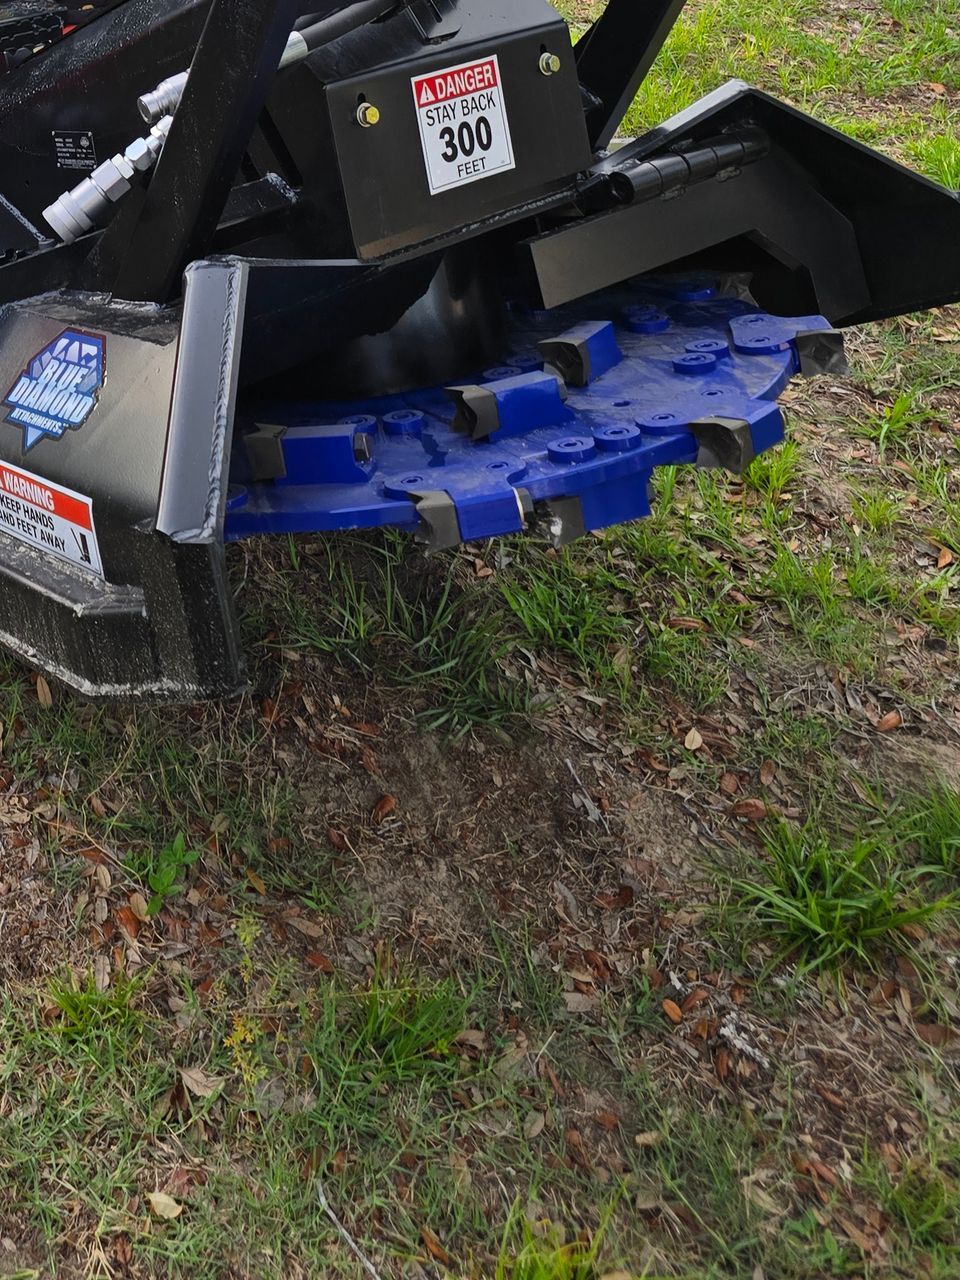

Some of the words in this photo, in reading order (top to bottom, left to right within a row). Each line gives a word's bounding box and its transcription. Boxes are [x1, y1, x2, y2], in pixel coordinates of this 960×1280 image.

[435, 64, 495, 100] DANGER
[426, 101, 457, 127] STAY
[461, 91, 496, 117] BACK
[439, 115, 493, 163] 300
[457, 156, 487, 178] FEET
[38, 358, 89, 394] BLUE
[7, 376, 95, 424] DIAMOND
[9, 407, 61, 433] ATTACHMENTS
[2, 470, 56, 512] WARNING
[17, 518, 39, 539] FEET
[40, 529, 67, 553] AWAY
[23, 506, 56, 532] HANDS
